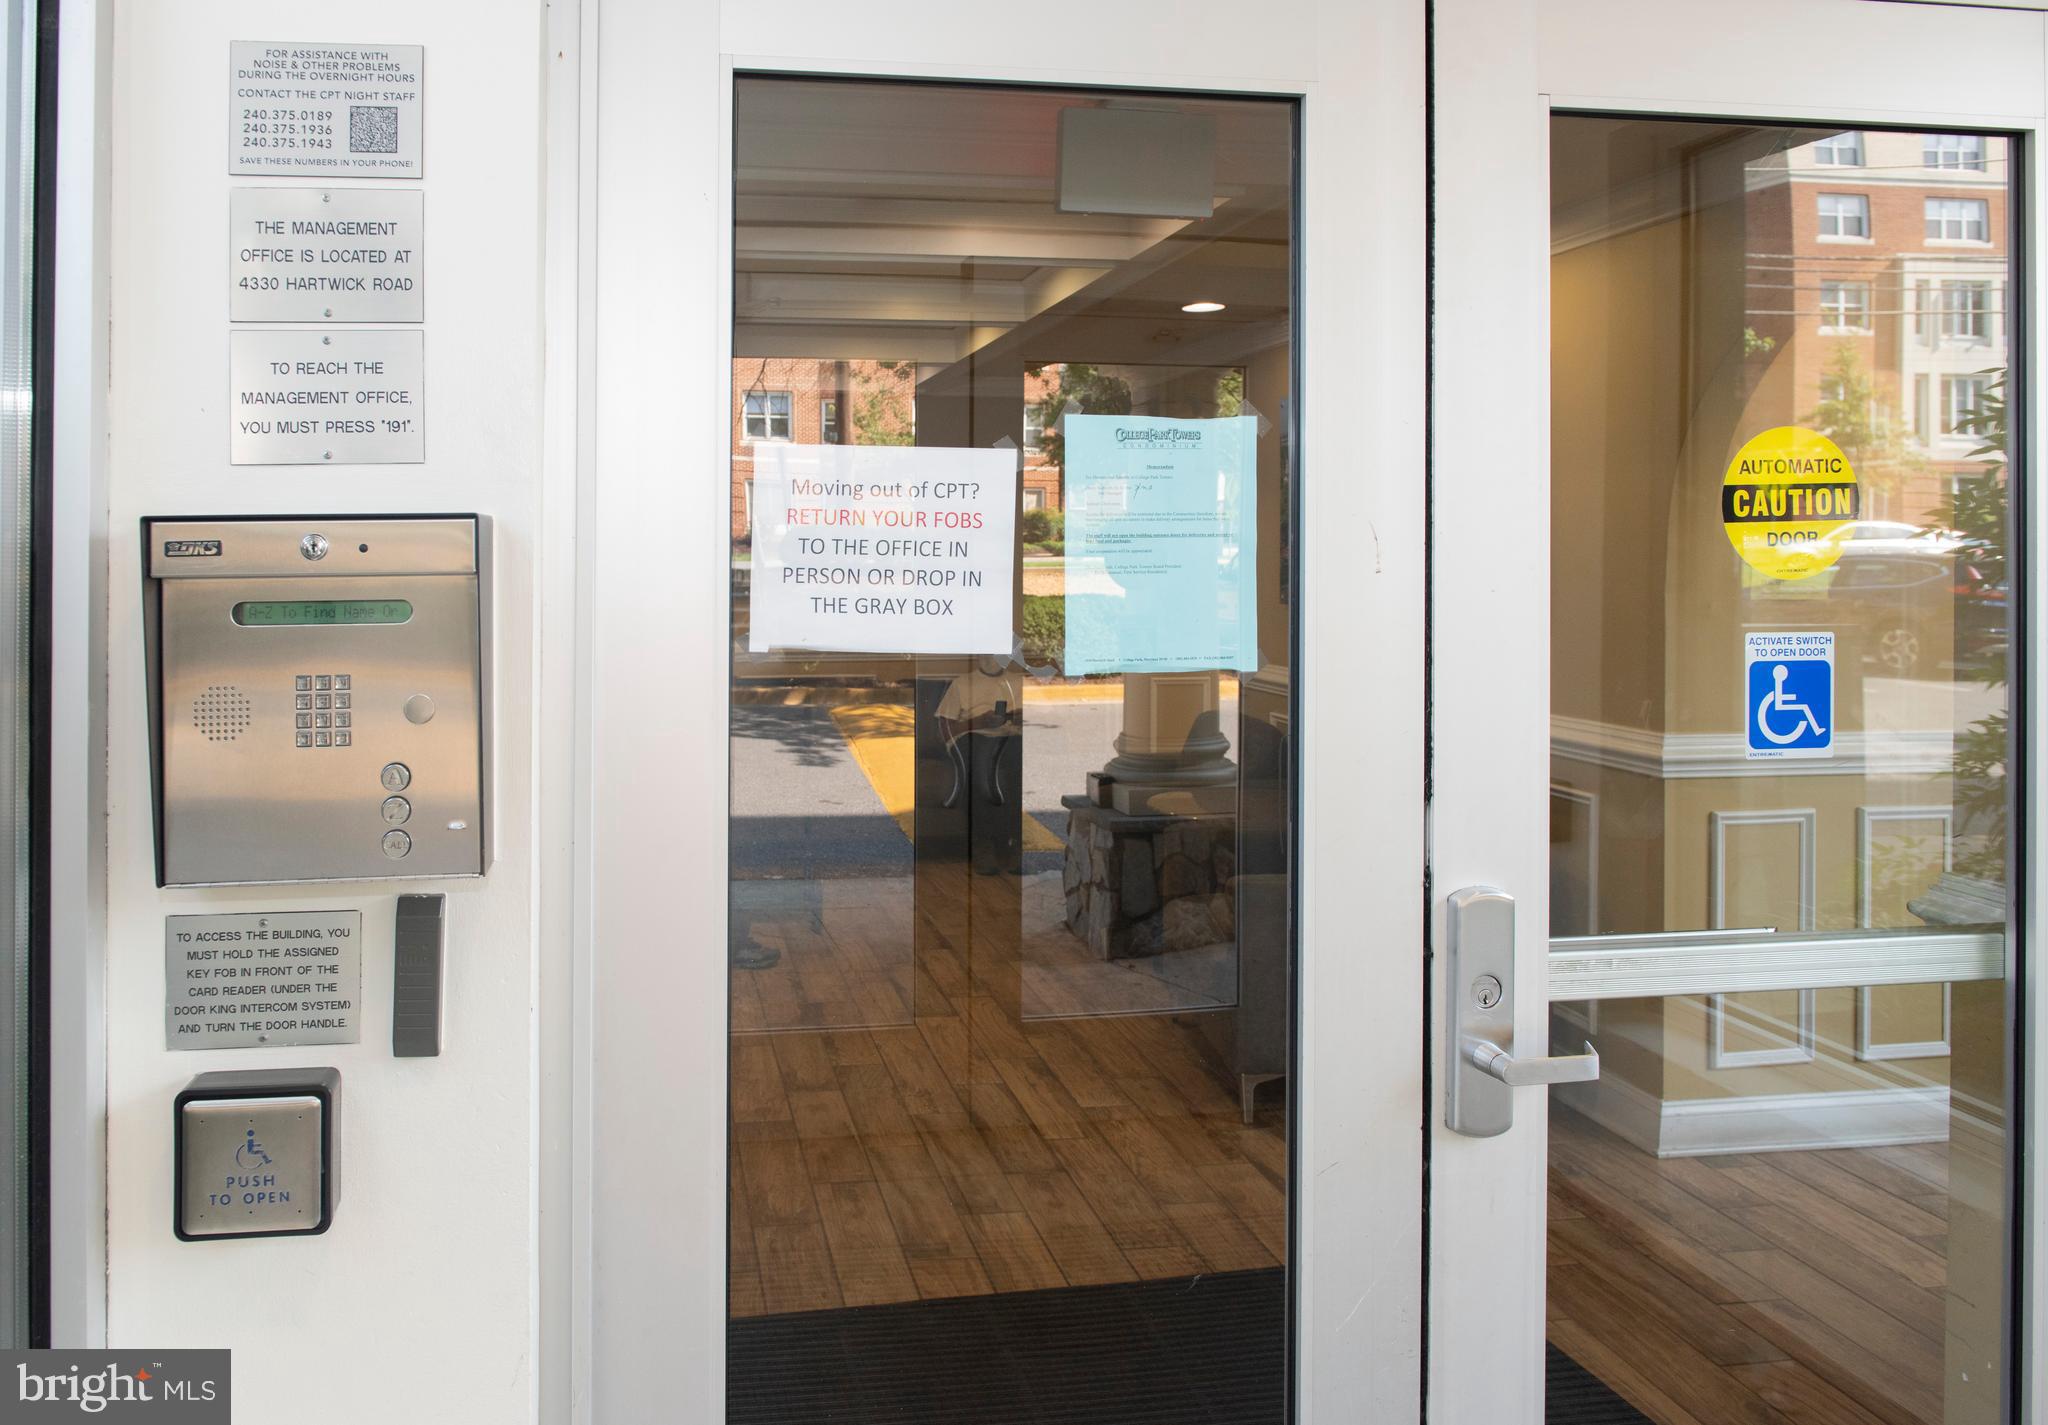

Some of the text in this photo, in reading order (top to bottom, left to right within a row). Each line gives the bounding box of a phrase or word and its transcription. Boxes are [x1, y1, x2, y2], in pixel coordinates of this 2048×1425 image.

[265, 49, 389, 61] FOR ASSISTANCE WITH
[253, 60, 401, 72] NOISE & OTHER PROBLEMS
[238, 70, 415, 83] DURING THE OVERNIGHT HOURS
[238, 88, 415, 101] CONTACT THE CPT NIGHT STAFF
[243, 109, 333, 121] 240.375.0189
[243, 123, 333, 135] 240.375.1936
[243, 137, 333, 149] 240.375.1943
[239, 156, 262, 164] SAVE
[264, 157, 292, 165] THESE
[294, 158, 338, 166] NUMBERS
[353, 159, 377, 167] YOUR
[379, 160, 414, 168] PHONE!
[255, 221, 398, 236] THE MANAGEMENT
[240, 249, 412, 263] OFFICE IS LOCATED AT
[239, 277, 413, 291] 4330 HARTWICK ROAD
[270, 361, 384, 375] TO REACH THE
[241, 390, 413, 406] MANAGEMENT OFFICE,
[240, 419, 414, 434] YOU MUST PRESS "191".
[1739, 458, 1843, 475] AUTOMATIC
[792, 478, 980, 500] Moving out of CPT?
[1733, 487, 1852, 517] CAUTION
[786, 508, 983, 529] RETURN YOUR FOBS
[1767, 531, 1819, 547] DOOR
[798, 538, 968, 558] TO THE OFFICE IN
[783, 567, 982, 587] PERSON OR DROP IN
[248, 605, 273, 619] A-Z
[281, 604, 297, 618] To
[303, 604, 337, 618] Find
[343, 603, 375, 618] Name
[810, 597, 953, 616] THE GRAY BOX
[1748, 636, 1832, 646] ACTIVATE SWITCH
[1755, 647, 1827, 657] TO OPEN DOOR
[176, 928, 351, 943] TO ACCESS THE BUILDING, YOU
[187, 947, 339, 961] MUST HOLD THE ASSIGNED
[186, 964, 339, 979] KEY FOB IN FRONT OF THE
[188, 982, 338, 997] CARD READER (UNDER THE
[174, 1000, 352, 1016] DOOR KING INTERCOM SYSTEM)
[178, 1018, 348, 1034] AND TURN THE DOOR HANDLE.
[226, 1175, 276, 1189] PUSH
[209, 1191, 291, 1206] TO OPEN
